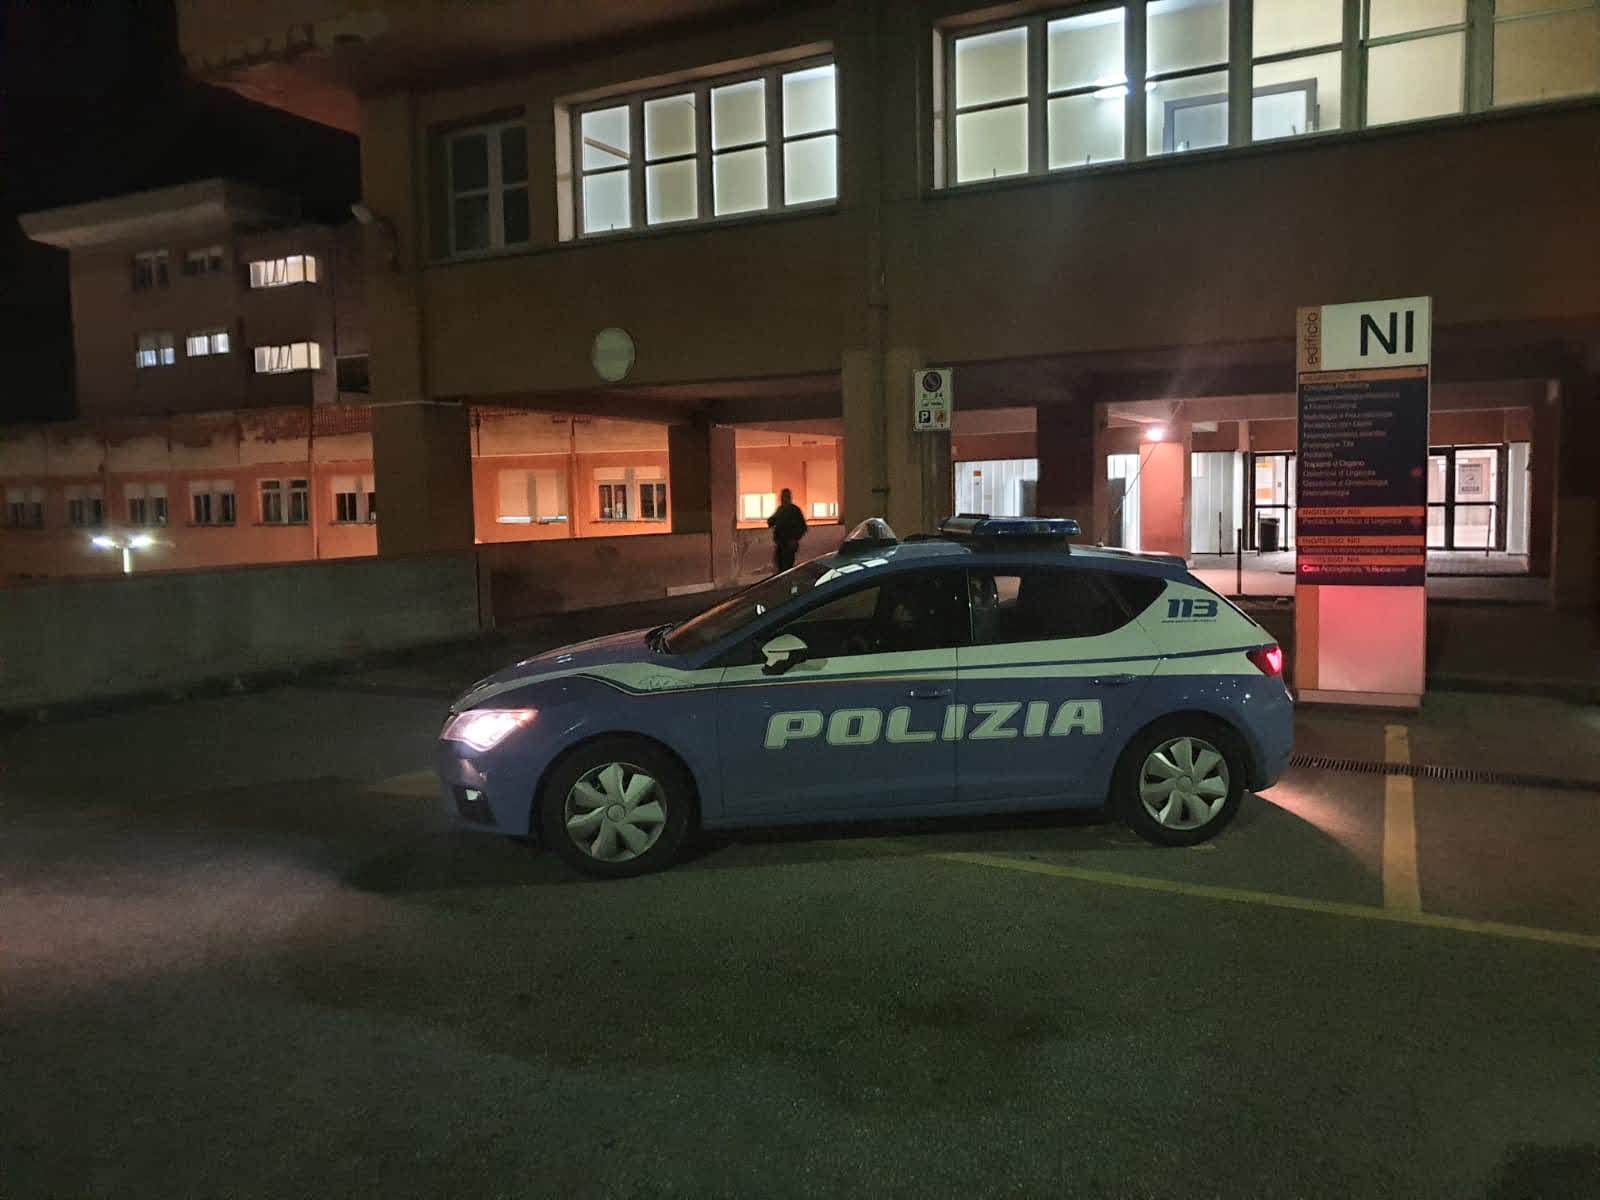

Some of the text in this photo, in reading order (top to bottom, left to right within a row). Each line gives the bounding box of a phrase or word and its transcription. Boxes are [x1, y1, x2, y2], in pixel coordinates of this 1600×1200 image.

[1304, 311, 1319, 365] edificio
[1360, 310, 1414, 357] NI
[1167, 599, 1218, 618] 113
[763, 697, 1104, 750] POLIZIA
